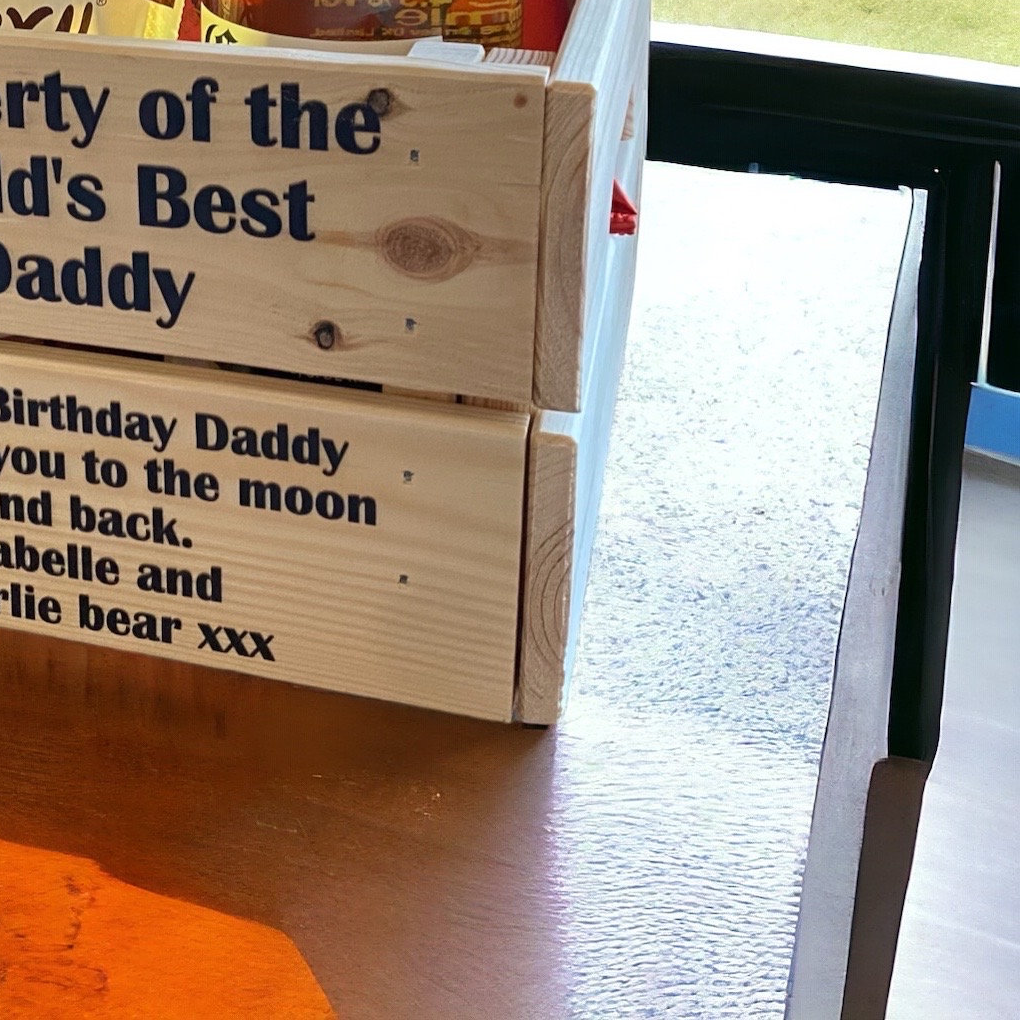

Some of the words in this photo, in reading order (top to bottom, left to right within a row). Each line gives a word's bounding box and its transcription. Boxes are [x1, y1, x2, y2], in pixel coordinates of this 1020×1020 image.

[138, 77, 219, 143] of
[244, 82, 381, 155] the
[137, 164, 316, 242] Best
[195, 413, 349, 476] Daddy
[82, 450, 128, 488] to
[144, 459, 220, 501] the
[238, 478, 377, 526] moon
[70, 495, 193, 549] back.
[137, 563, 222, 603] and
[79, 594, 182, 644] bear
[197, 622, 275, 661] xxx
